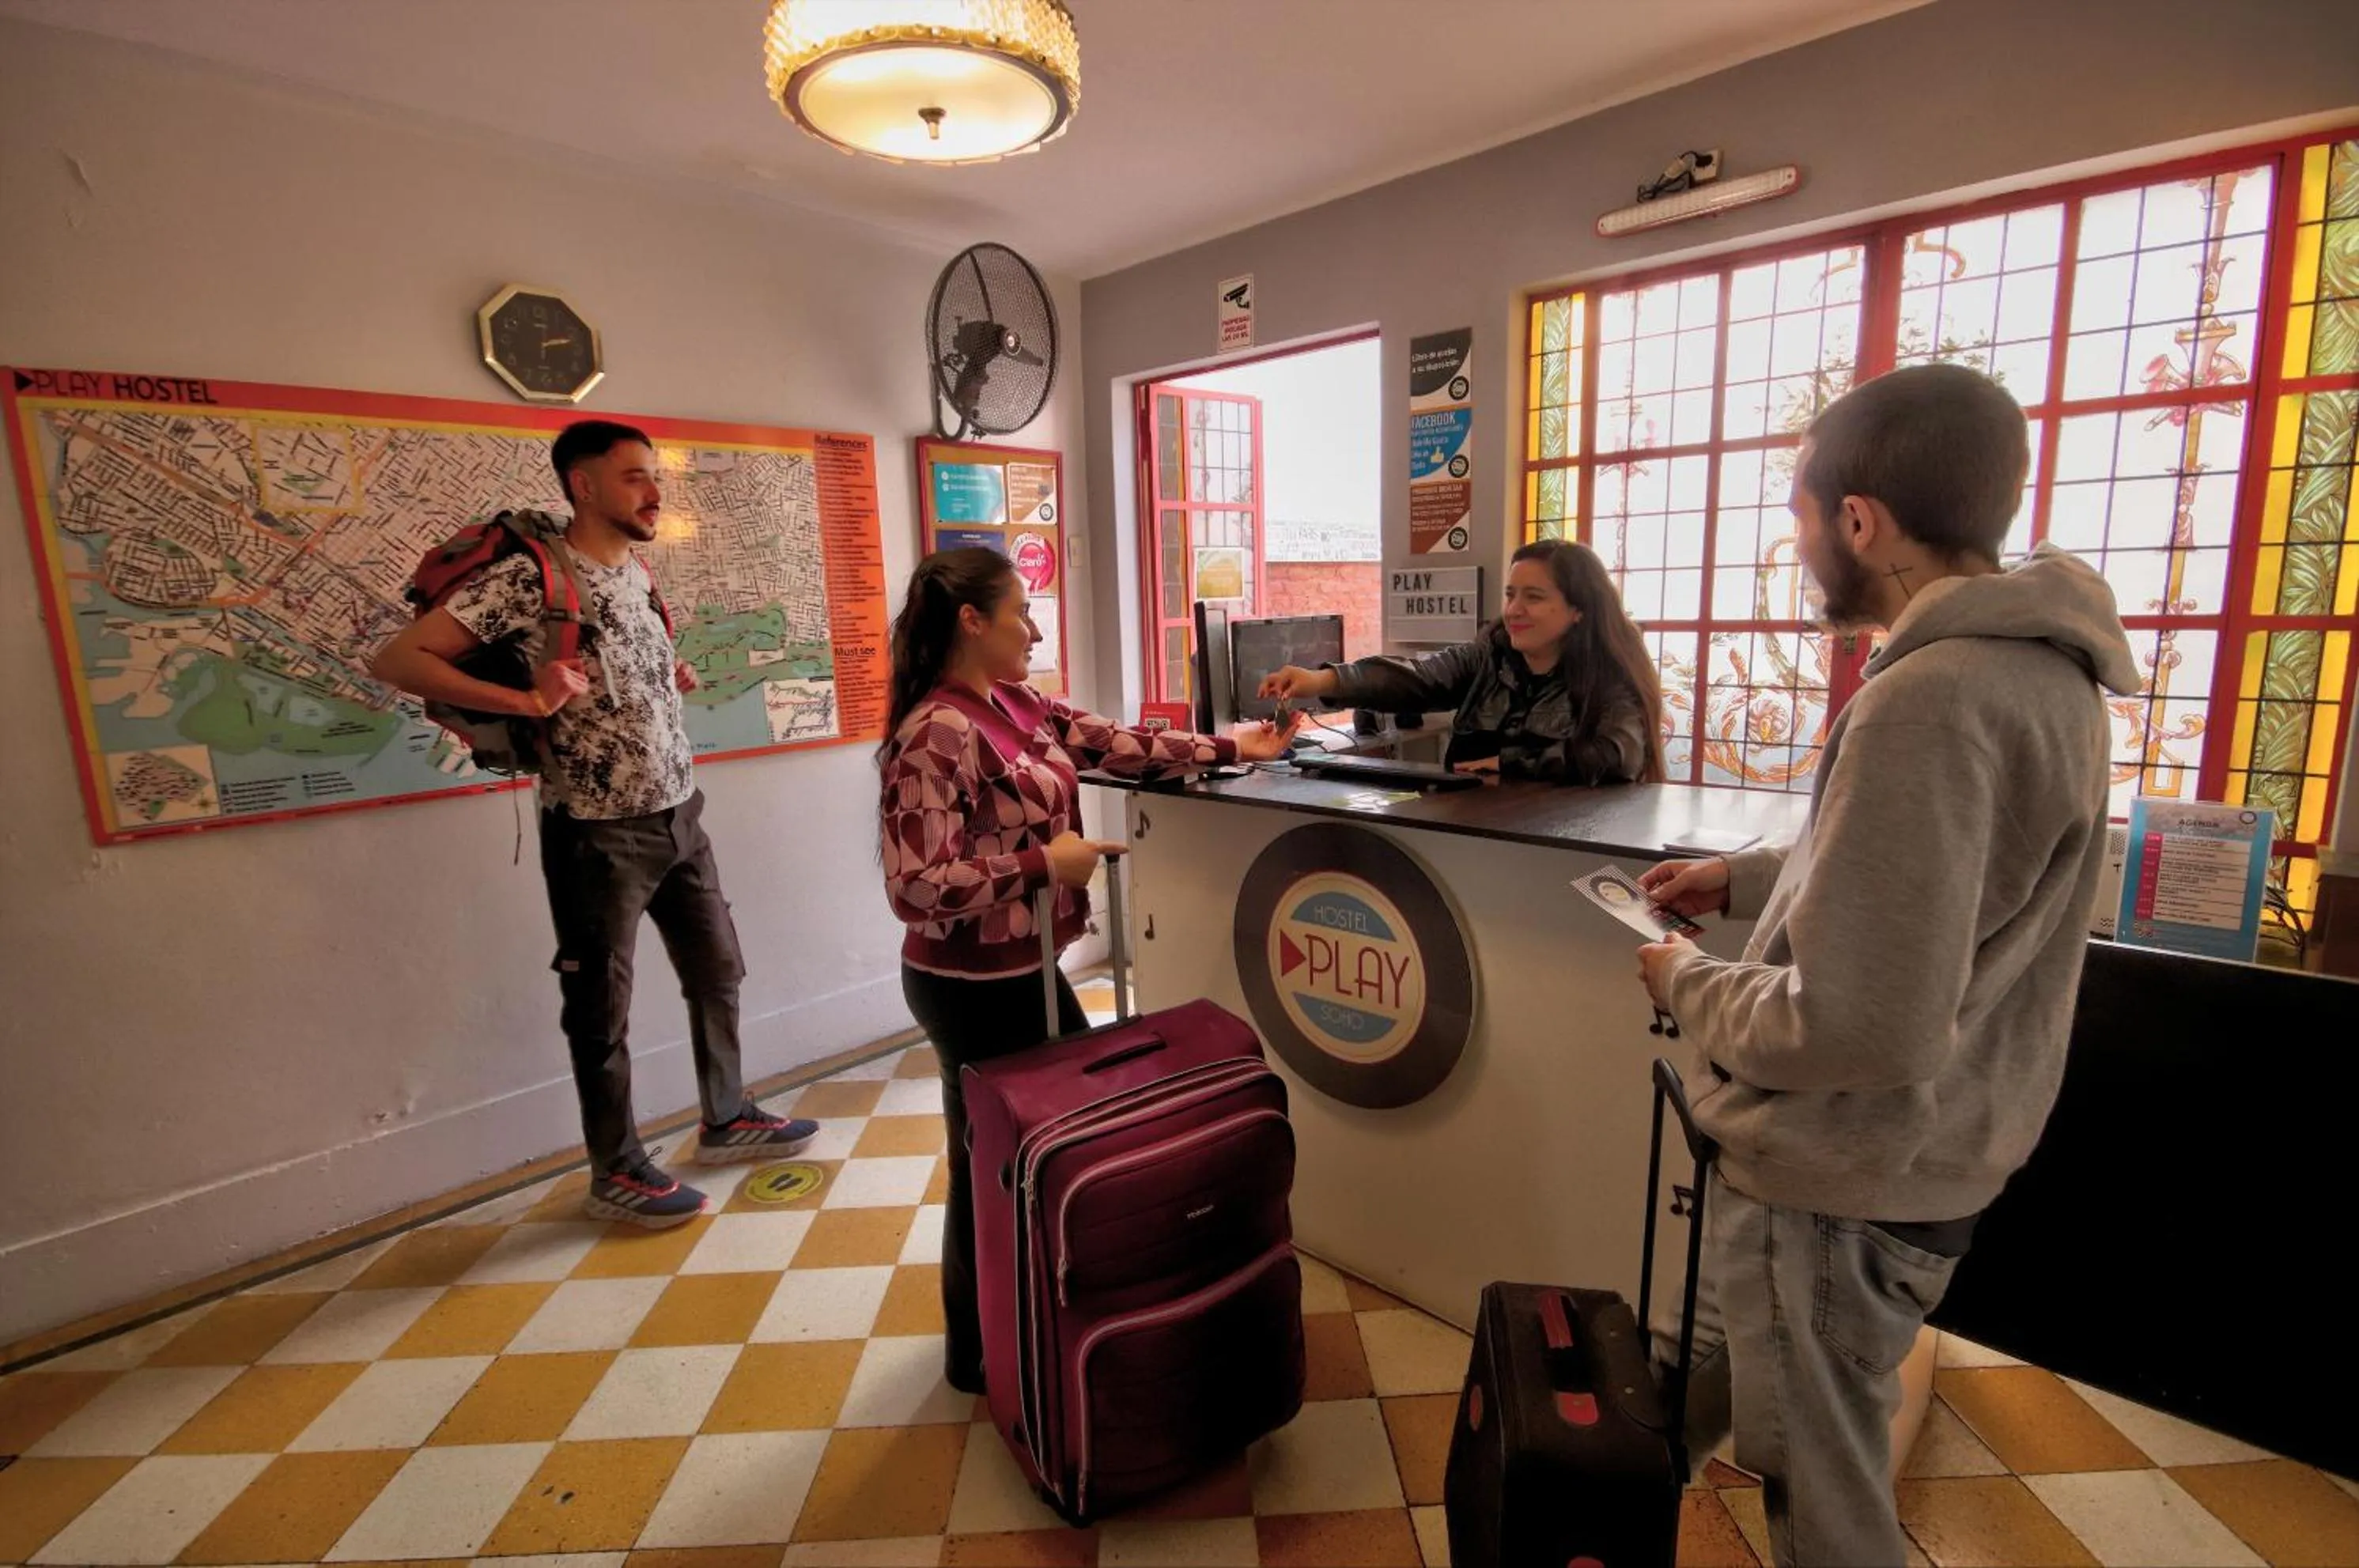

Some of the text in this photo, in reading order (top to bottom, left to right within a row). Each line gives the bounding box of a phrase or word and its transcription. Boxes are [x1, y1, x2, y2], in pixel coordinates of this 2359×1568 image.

[33, 370, 218, 404] PLAY HOSTEL
[1412, 412, 1456, 429] FACEBOOK
[1392, 572, 1433, 591] PLAY
[1405, 595, 1467, 615] HOSTEL
[834, 647, 858, 657] Must
[1314, 905, 1369, 932] HOSTEL
[1304, 933, 1410, 1009] PLAY
[1320, 1004, 1366, 1030] SOHO
